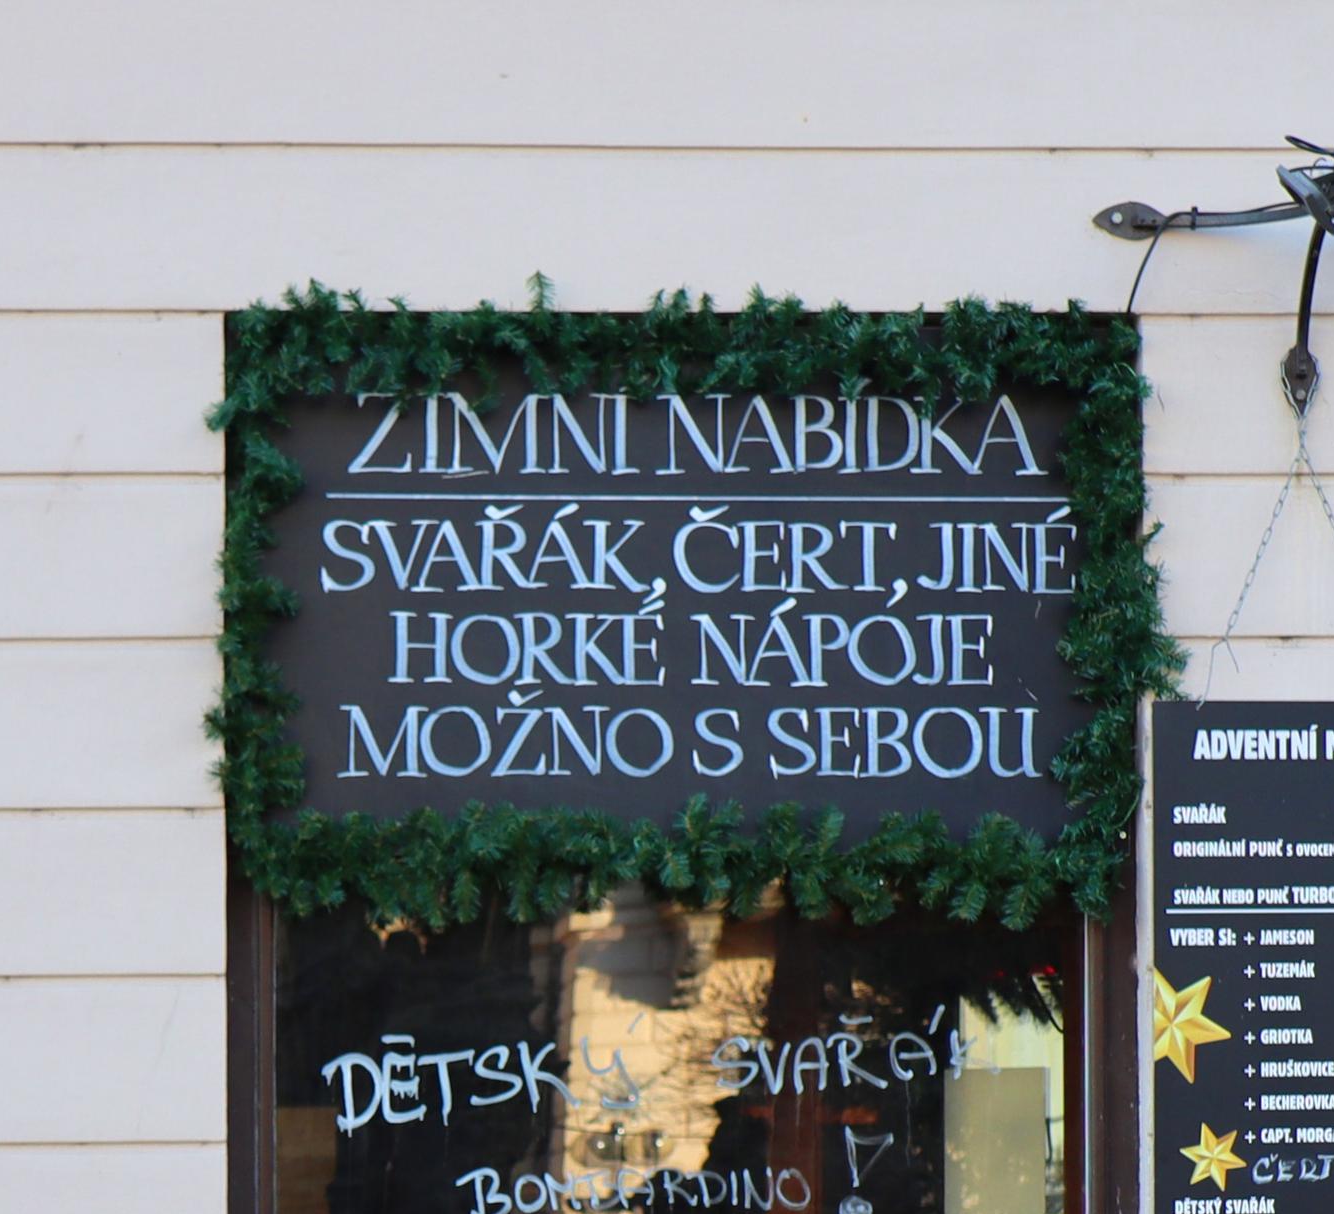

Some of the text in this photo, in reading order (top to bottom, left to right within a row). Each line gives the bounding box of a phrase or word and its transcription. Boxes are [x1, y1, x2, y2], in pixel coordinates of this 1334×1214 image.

[655, 380, 1048, 476] NABÍDKA
[319, 503, 1078, 606] SVAŘÁK, ČERT, JINÉ
[387, 600, 667, 687] HORKÉ
[337, 689, 1044, 780] MOŽNO S SEBOU
[1194, 725, 1318, 760] ADVENTNÍ
[1174, 803, 1226, 824] SVAŘÁK
[1174, 838, 1245, 857] ORIGINÁLNÍ
[1250, 838, 1283, 857] PUNČ
[1174, 886, 1220, 904] SVAŘÁK
[1223, 889, 1254, 904] NEBO
[1257, 886, 1289, 904] PUNČ
[1170, 928, 1215, 946] VYBER
[1218, 928, 1236, 946] SI:
[1260, 929, 1315, 945] JAMESON
[1260, 960, 1315, 978] TUZEMÁK
[1261, 996, 1301, 1011] VODKA
[1261, 1029, 1313, 1044] GRIOTKA
[711, 1004, 1002, 1095] SVAŘÁK
[1261, 1059, 1334, 1077] HRUŠKOVICE
[1261, 1128, 1293, 1143] CAPT.
[1175, 1197, 1222, 1214] DĚTSKÝ
[1226, 1196, 1275, 1214] SVAŘÁK
